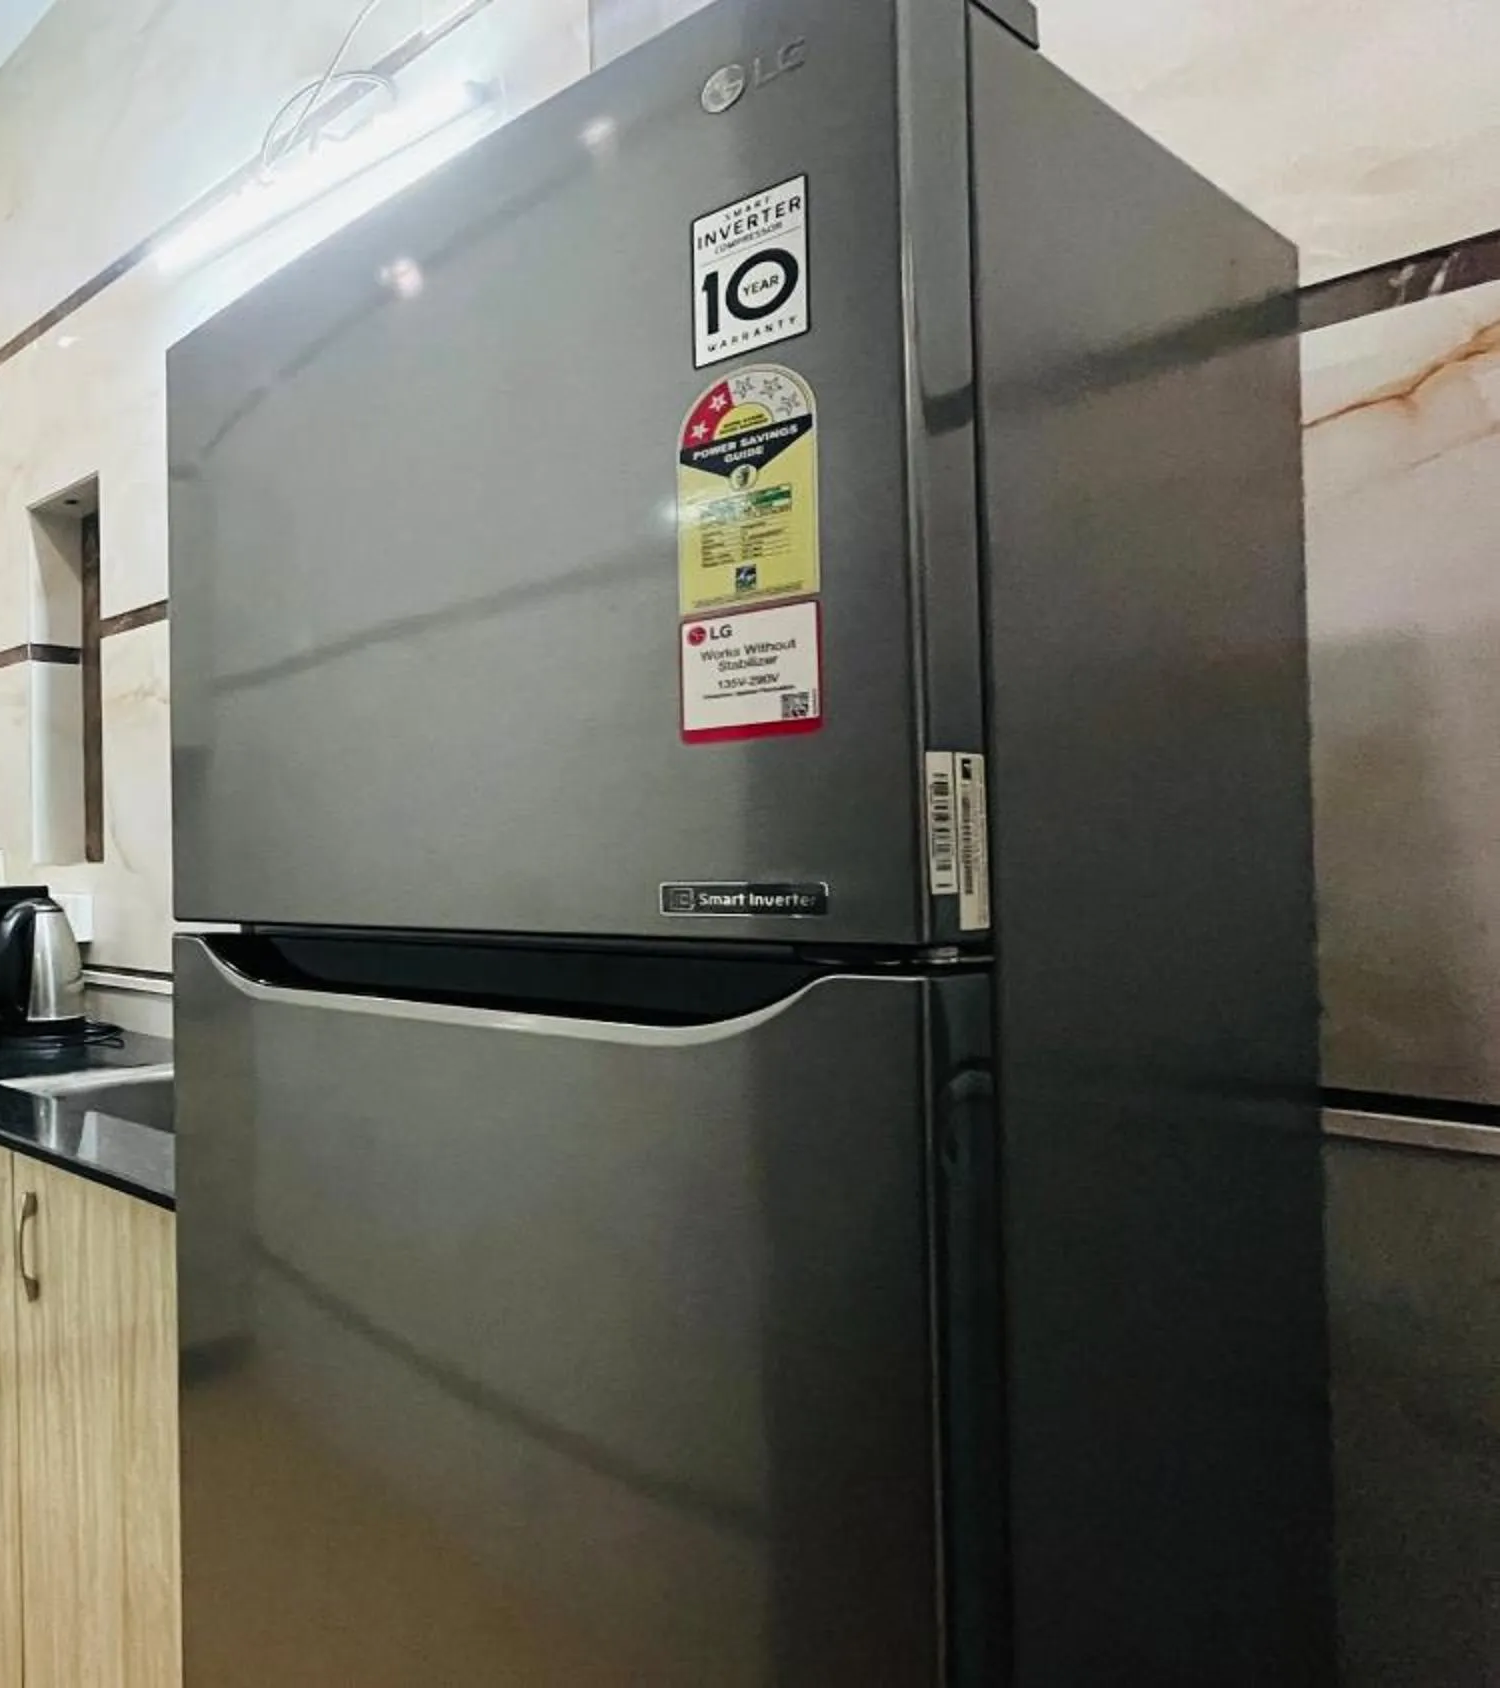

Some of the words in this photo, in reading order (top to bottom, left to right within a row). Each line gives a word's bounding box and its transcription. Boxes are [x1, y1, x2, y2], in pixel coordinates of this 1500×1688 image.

[752, 36, 806, 91] LG
[697, 196, 801, 251] INVERTER
[702, 248, 799, 335] 10
[743, 275, 779, 296] YEAR
[707, 316, 797, 352] WARRANTY
[692, 442, 737, 461] POWER
[740, 424, 799, 447] SAVINGS
[724, 446, 765, 463] GUIDE
[709, 624, 733, 640] LG
[700, 648, 740, 662] Works
[743, 638, 797, 655] Without
[717, 655, 778, 672] Stabilizer
[699, 893, 746, 907] Smart
[749, 893, 816, 907] Inverter
